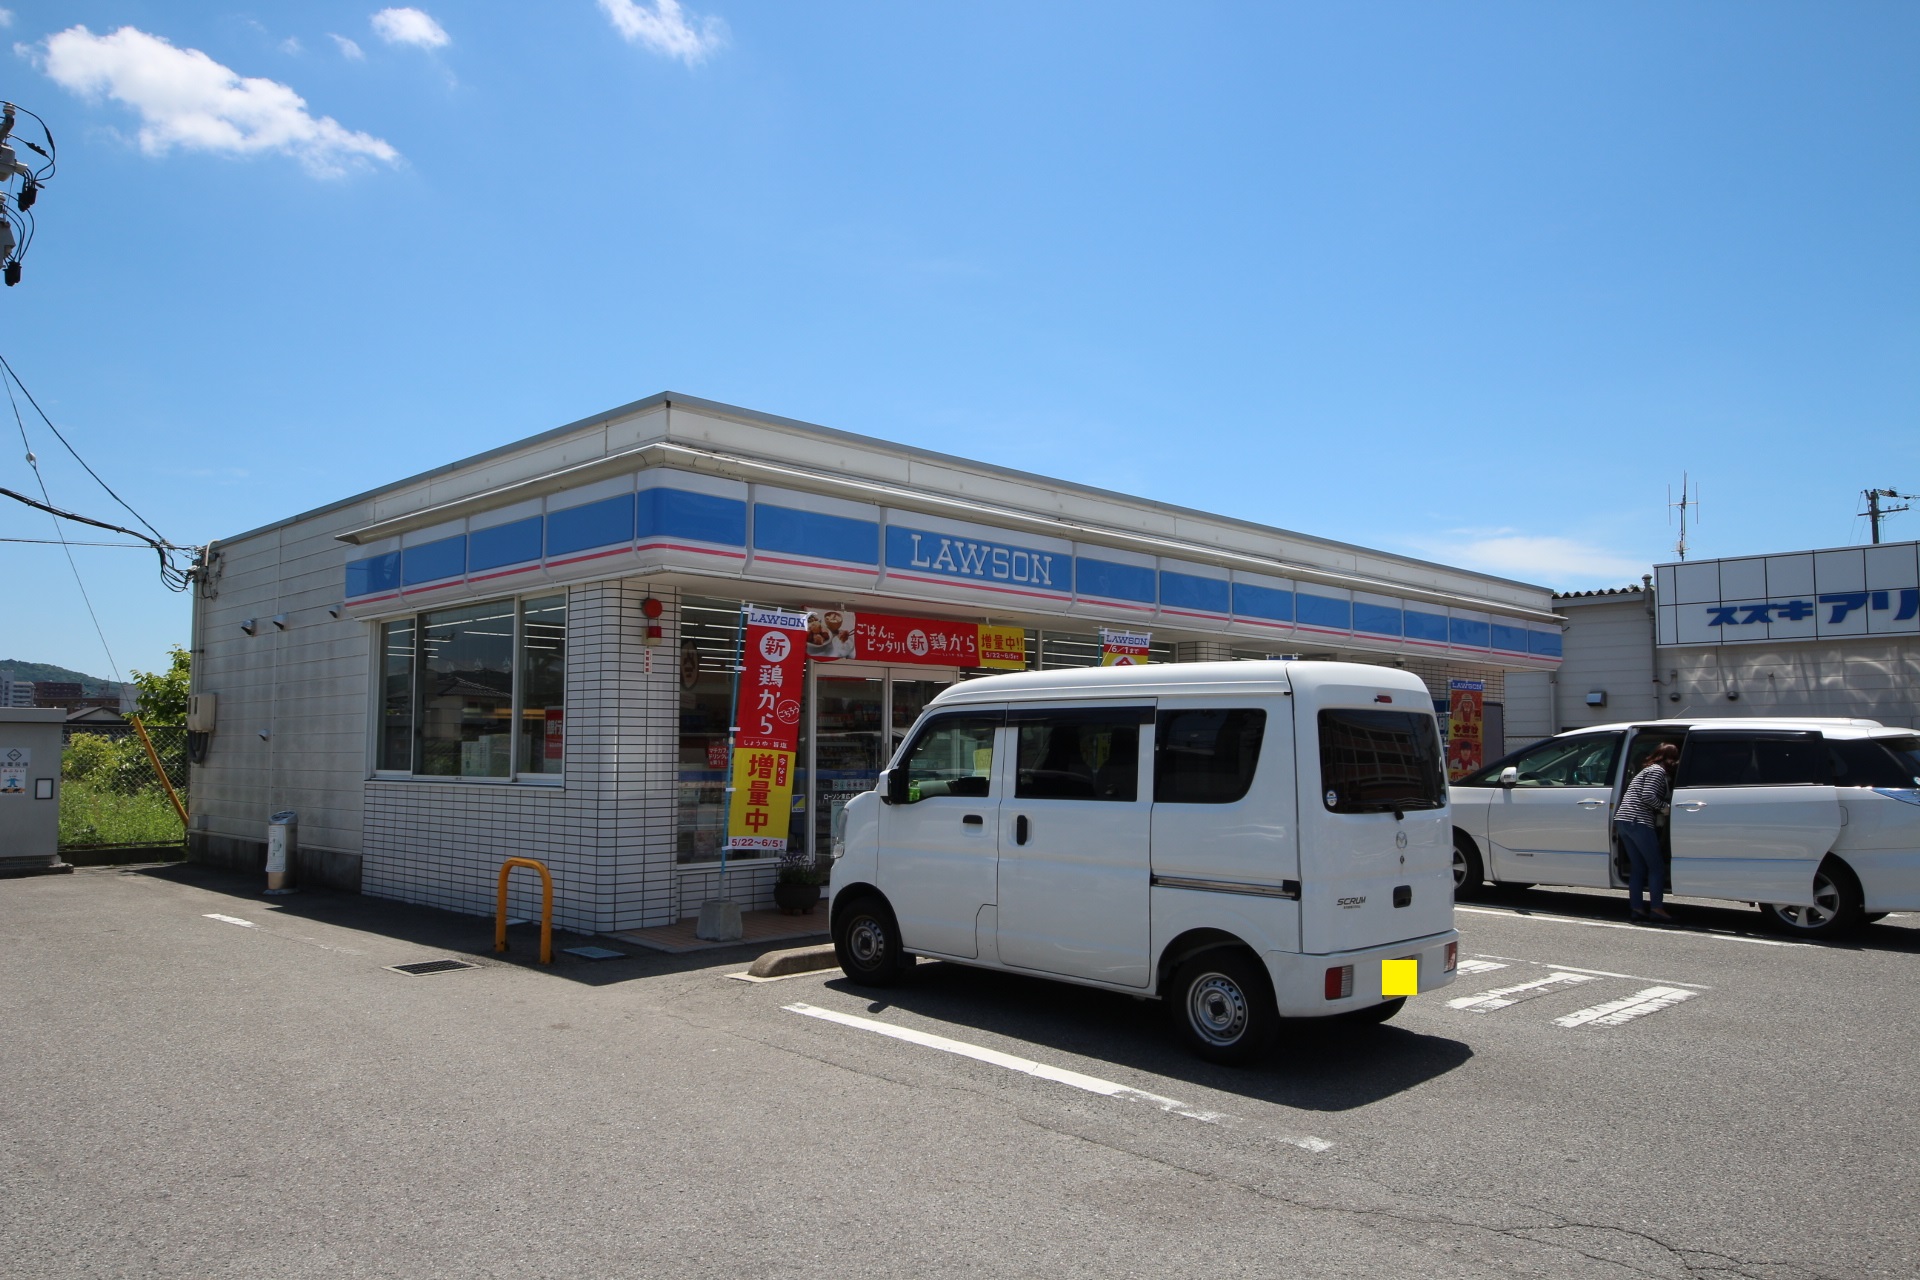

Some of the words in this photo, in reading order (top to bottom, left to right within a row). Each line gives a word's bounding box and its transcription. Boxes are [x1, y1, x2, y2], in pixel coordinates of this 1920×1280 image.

[911, 534, 1052, 585] LAWSON
[750, 613, 806, 628] LAWSON
[856, 623, 895, 640] ごはんに
[1106, 634, 1147, 645] LAWSON
[778, 758, 787, 784] 今なら
[745, 753, 774, 833] 増量中
[1337, 896, 1366, 906] SCRUM
